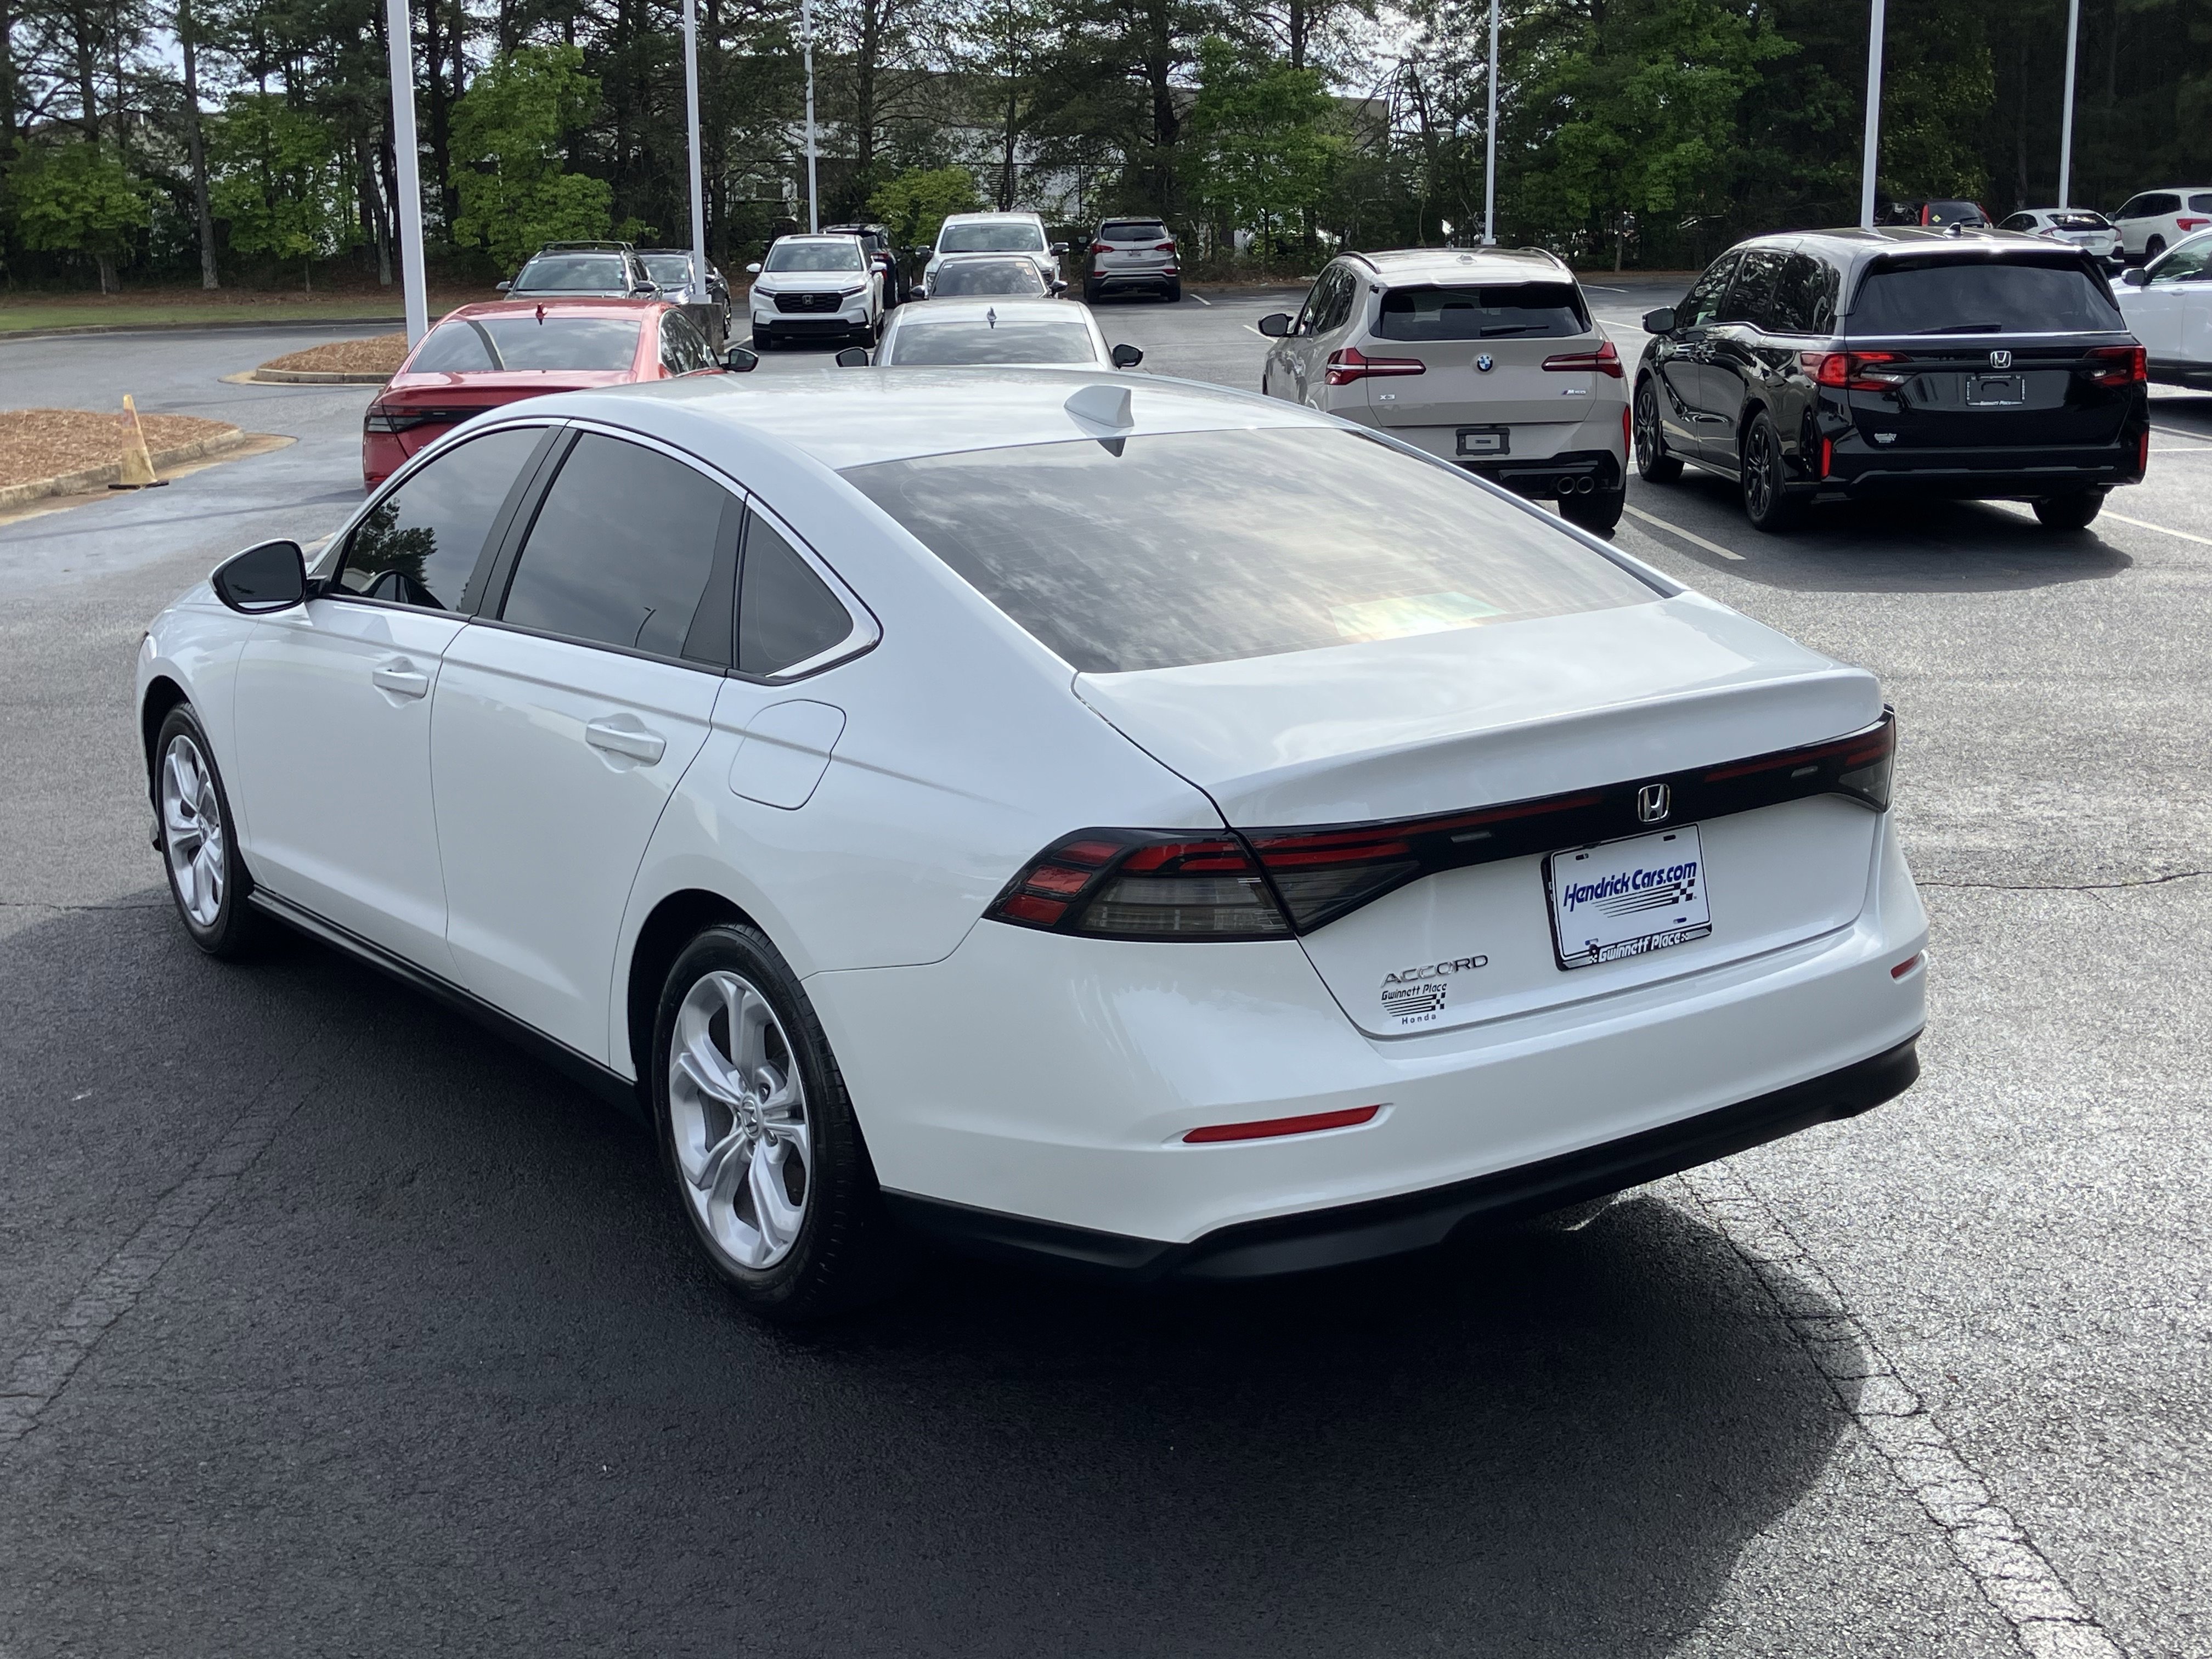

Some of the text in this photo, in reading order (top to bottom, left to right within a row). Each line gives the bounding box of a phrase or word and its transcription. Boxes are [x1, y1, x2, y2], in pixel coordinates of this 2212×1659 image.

[1563, 862, 1697, 912] Hendrick Cars.com
[1599, 933, 1681, 962] Gwinnett Place
[1380, 955, 1488, 988] ACCORD
[1381, 983, 1447, 1001] Gwinnett Place
[1402, 1013, 1436, 1024] Honda
